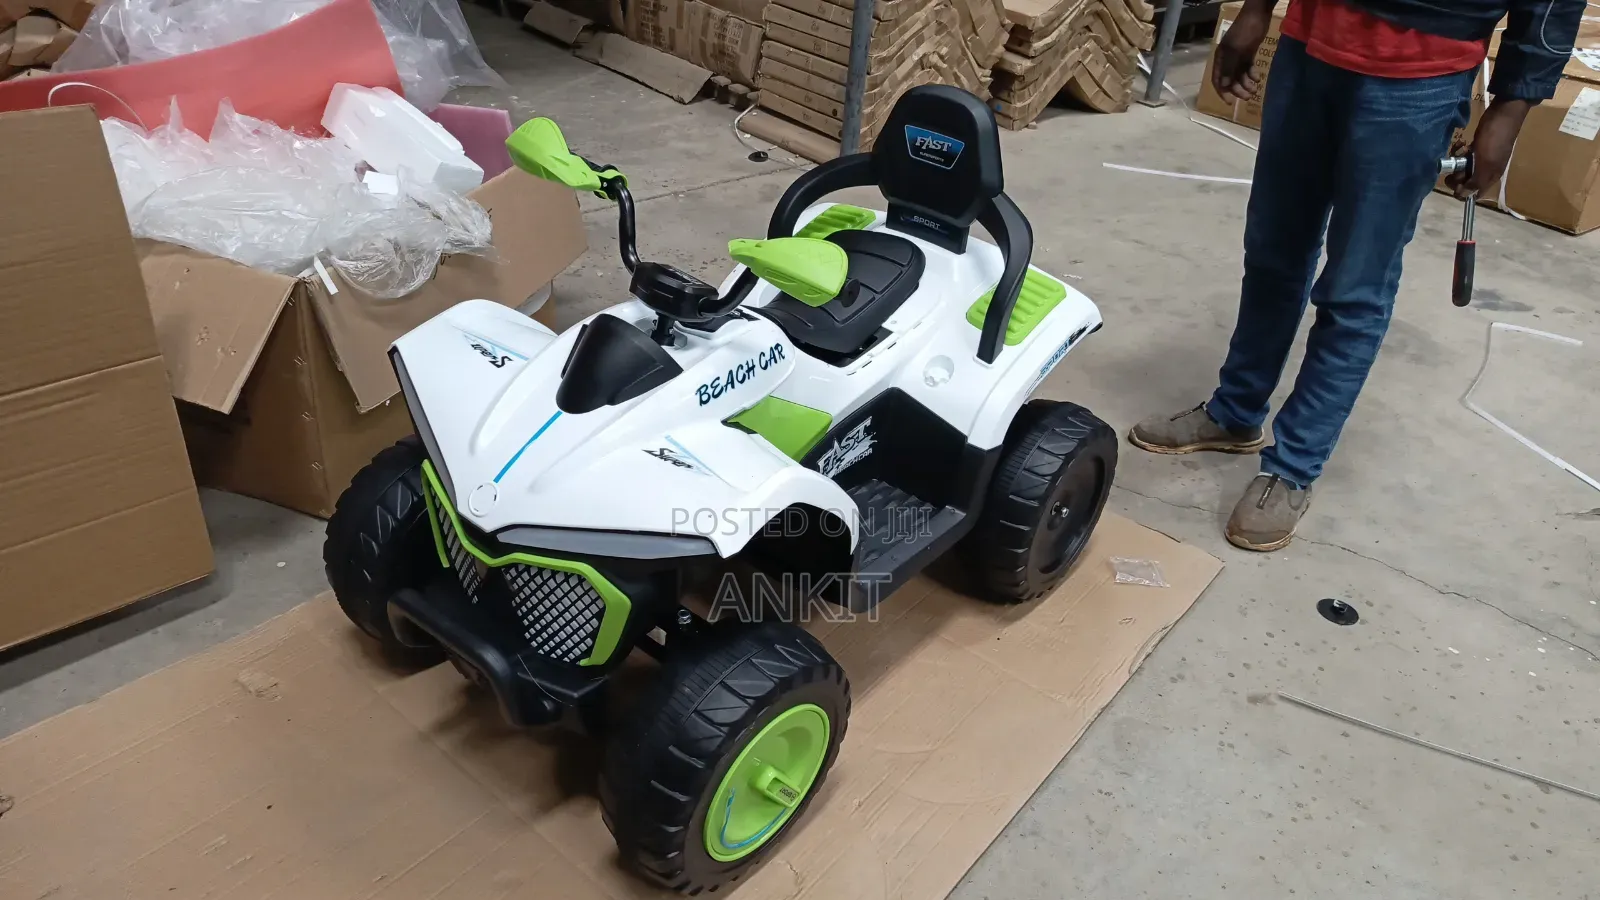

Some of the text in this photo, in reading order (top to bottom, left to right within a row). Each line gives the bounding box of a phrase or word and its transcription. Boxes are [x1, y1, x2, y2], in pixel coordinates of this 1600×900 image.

[915, 136, 952, 152] FAST
[913, 215, 941, 230] SPORT
[695, 342, 786, 407] BEACH CAR
[817, 415, 873, 477] FAST
